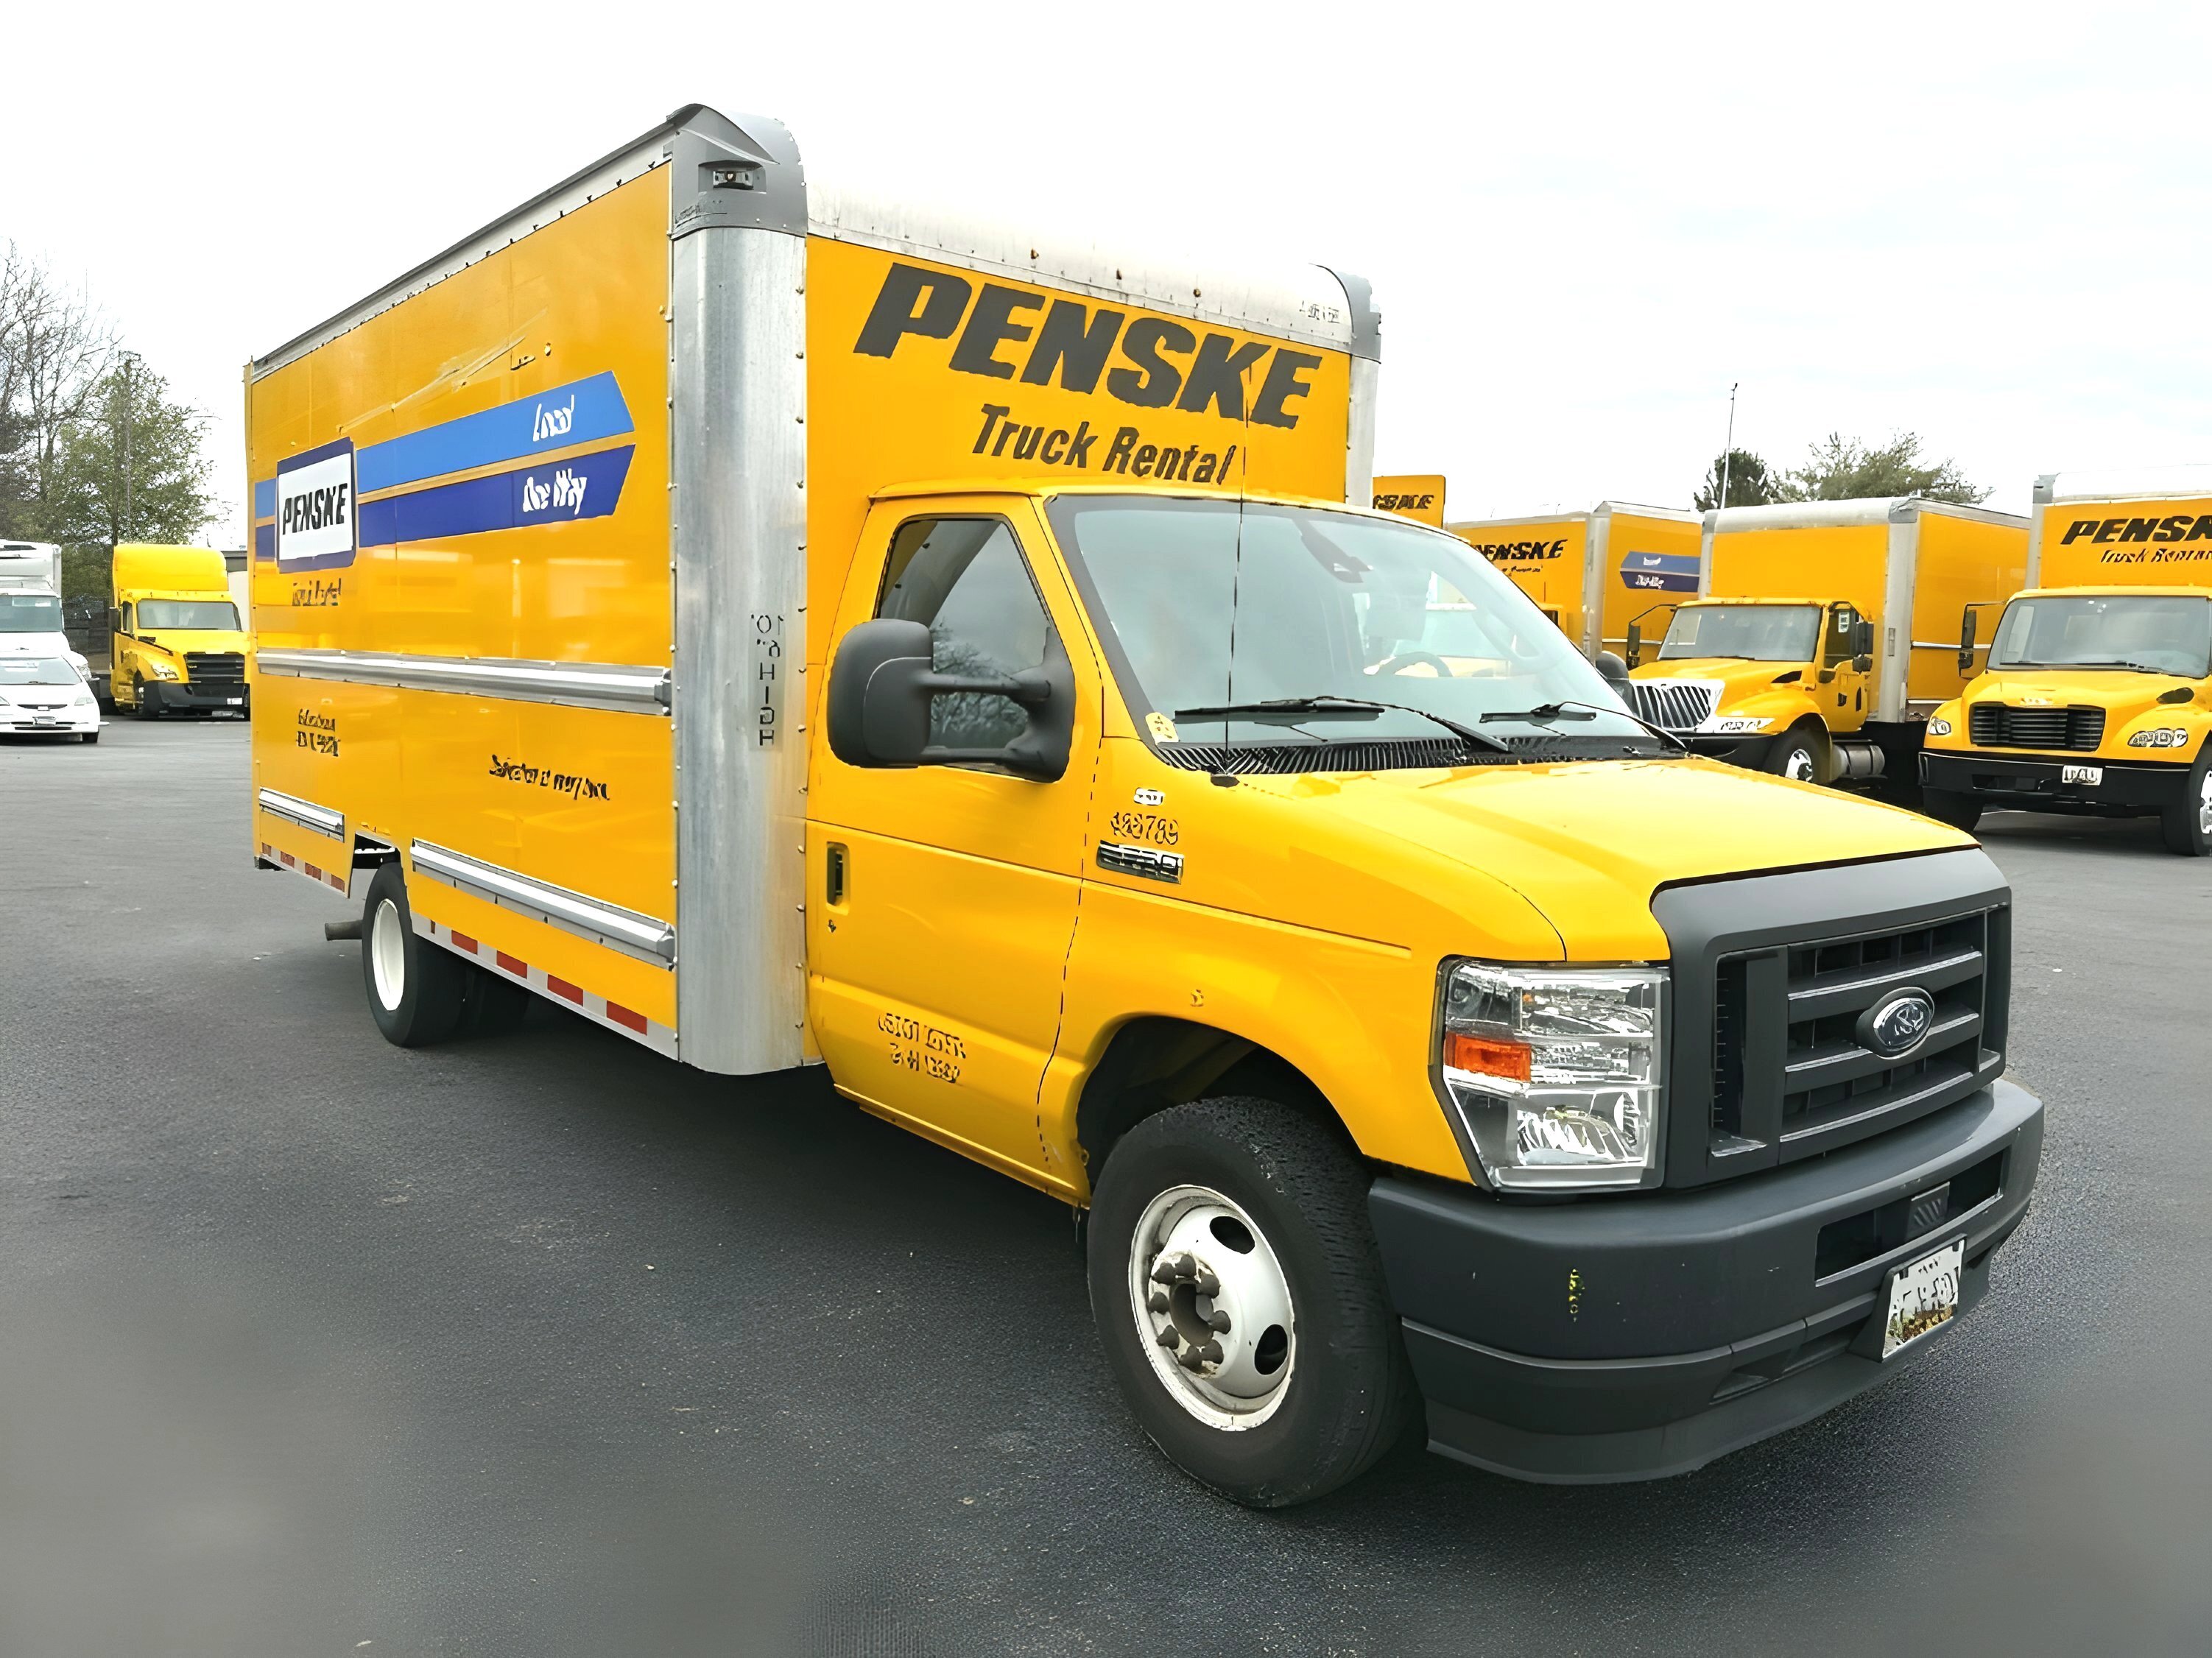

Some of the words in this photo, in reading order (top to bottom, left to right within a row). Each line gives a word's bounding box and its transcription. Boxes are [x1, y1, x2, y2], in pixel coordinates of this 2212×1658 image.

[853, 262, 1322, 431] PENSKE
[972, 403, 1098, 468] Truck
[1102, 426, 1236, 486] Rental
[283, 483, 348, 535] PENSKE
